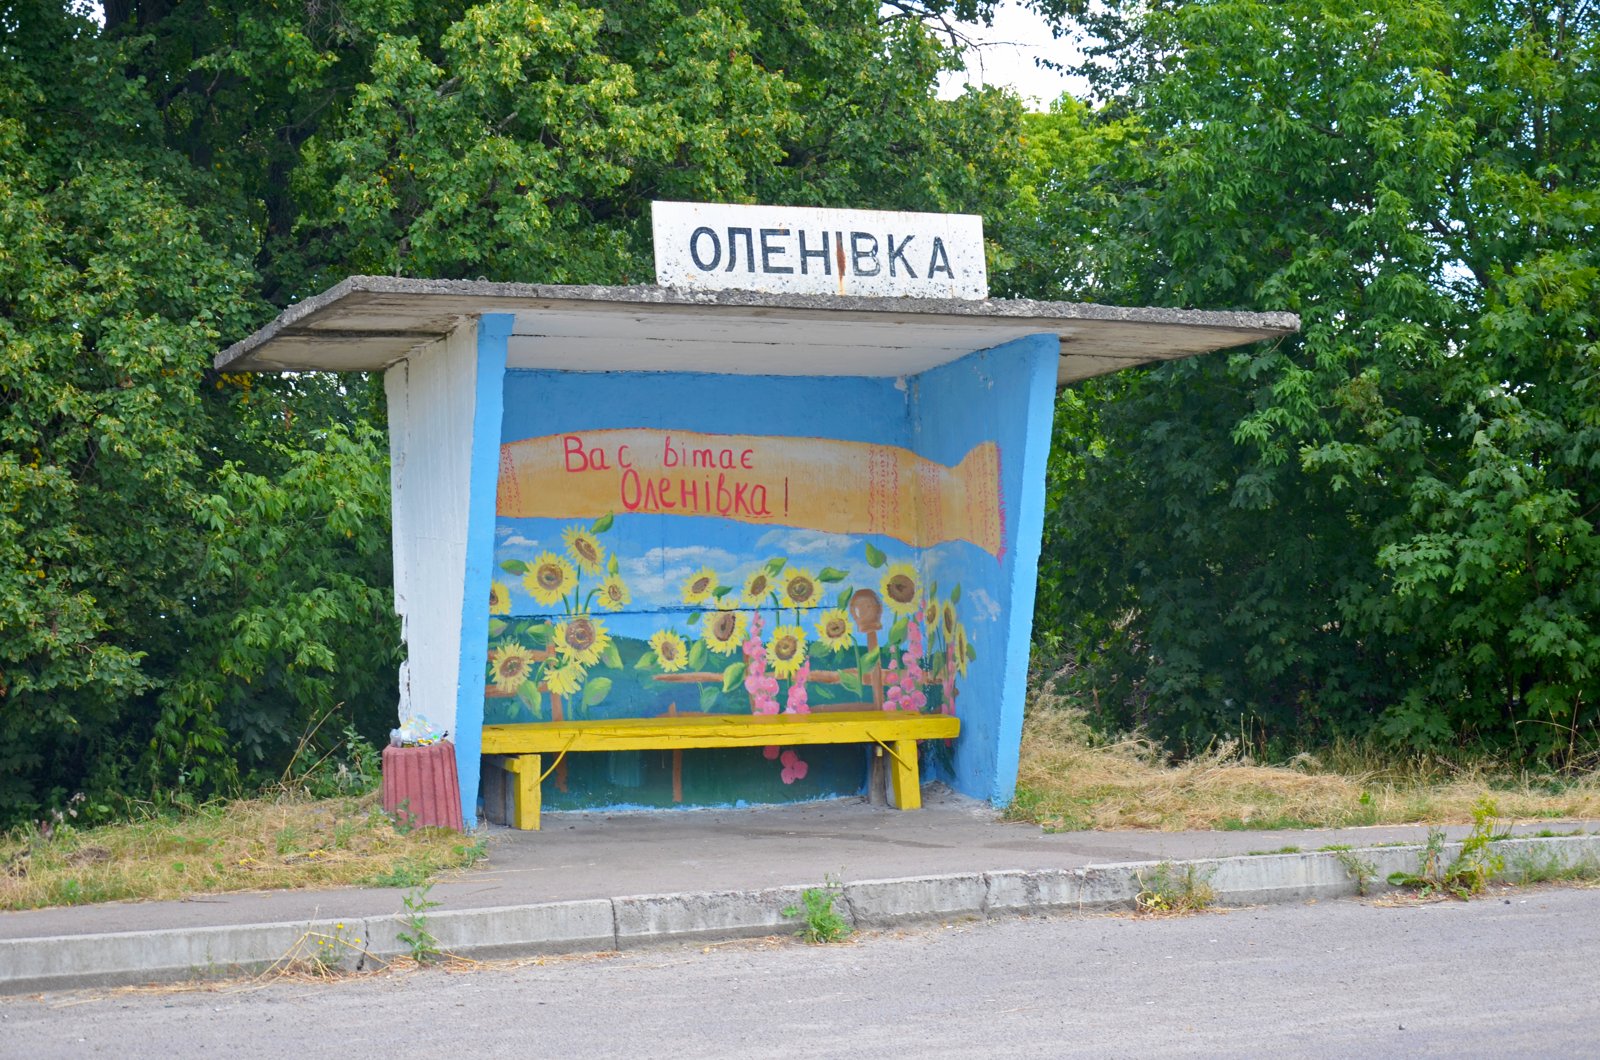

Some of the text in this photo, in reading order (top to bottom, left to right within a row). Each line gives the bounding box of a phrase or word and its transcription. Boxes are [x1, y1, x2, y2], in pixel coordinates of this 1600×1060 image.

[689, 226, 954, 280] ОЛЕНІВКА
[563, 435, 754, 473] Вас вітає
